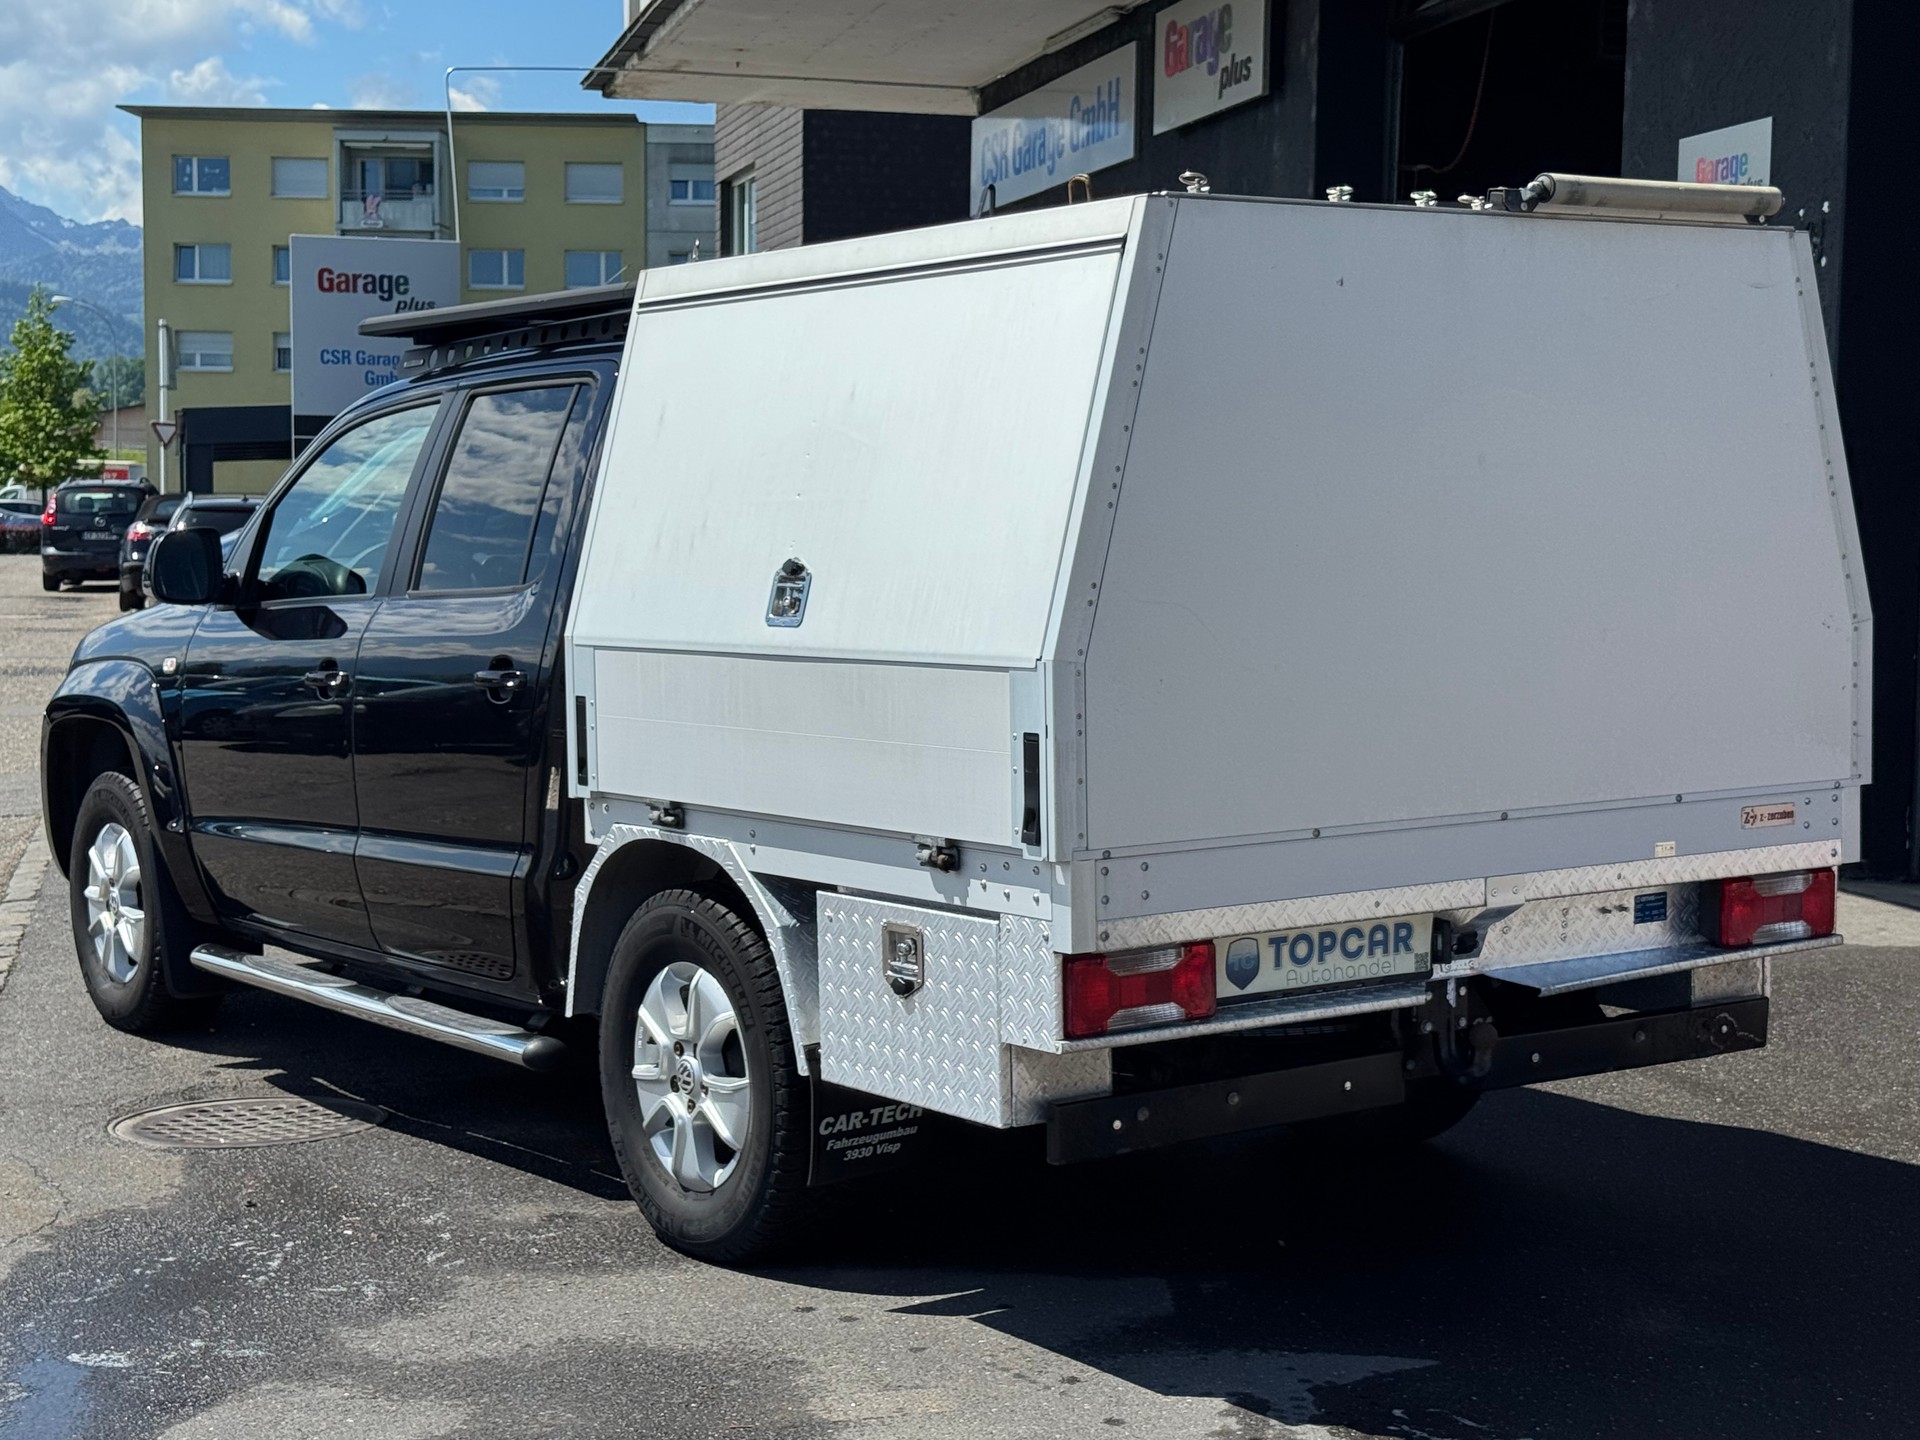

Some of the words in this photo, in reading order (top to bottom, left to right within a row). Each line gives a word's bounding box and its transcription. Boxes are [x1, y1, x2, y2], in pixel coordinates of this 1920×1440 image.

[1164, 3, 1232, 78] Garage
[1218, 53, 1252, 100] plus
[982, 129, 1008, 186] CSR
[1013, 119, 1064, 176] Garage
[1070, 77, 1120, 153] GmbH
[1694, 152, 1748, 184] Garage
[317, 267, 410, 301] Garage
[394, 297, 436, 313] plus
[320, 349, 352, 365] CSR
[355, 351, 400, 370] Garag
[364, 370, 398, 386] Gmb
[1268, 922, 1414, 970] TOPCAR
[696, 929, 756, 1026] MICHELIN
[1286, 958, 1396, 986] Autohandel
[819, 1104, 923, 1135] CAR-TECH
[826, 1126, 918, 1150] Fahrzeugumbau
[843, 1147, 873, 1161] 3930
[876, 1142, 901, 1154] Visp
